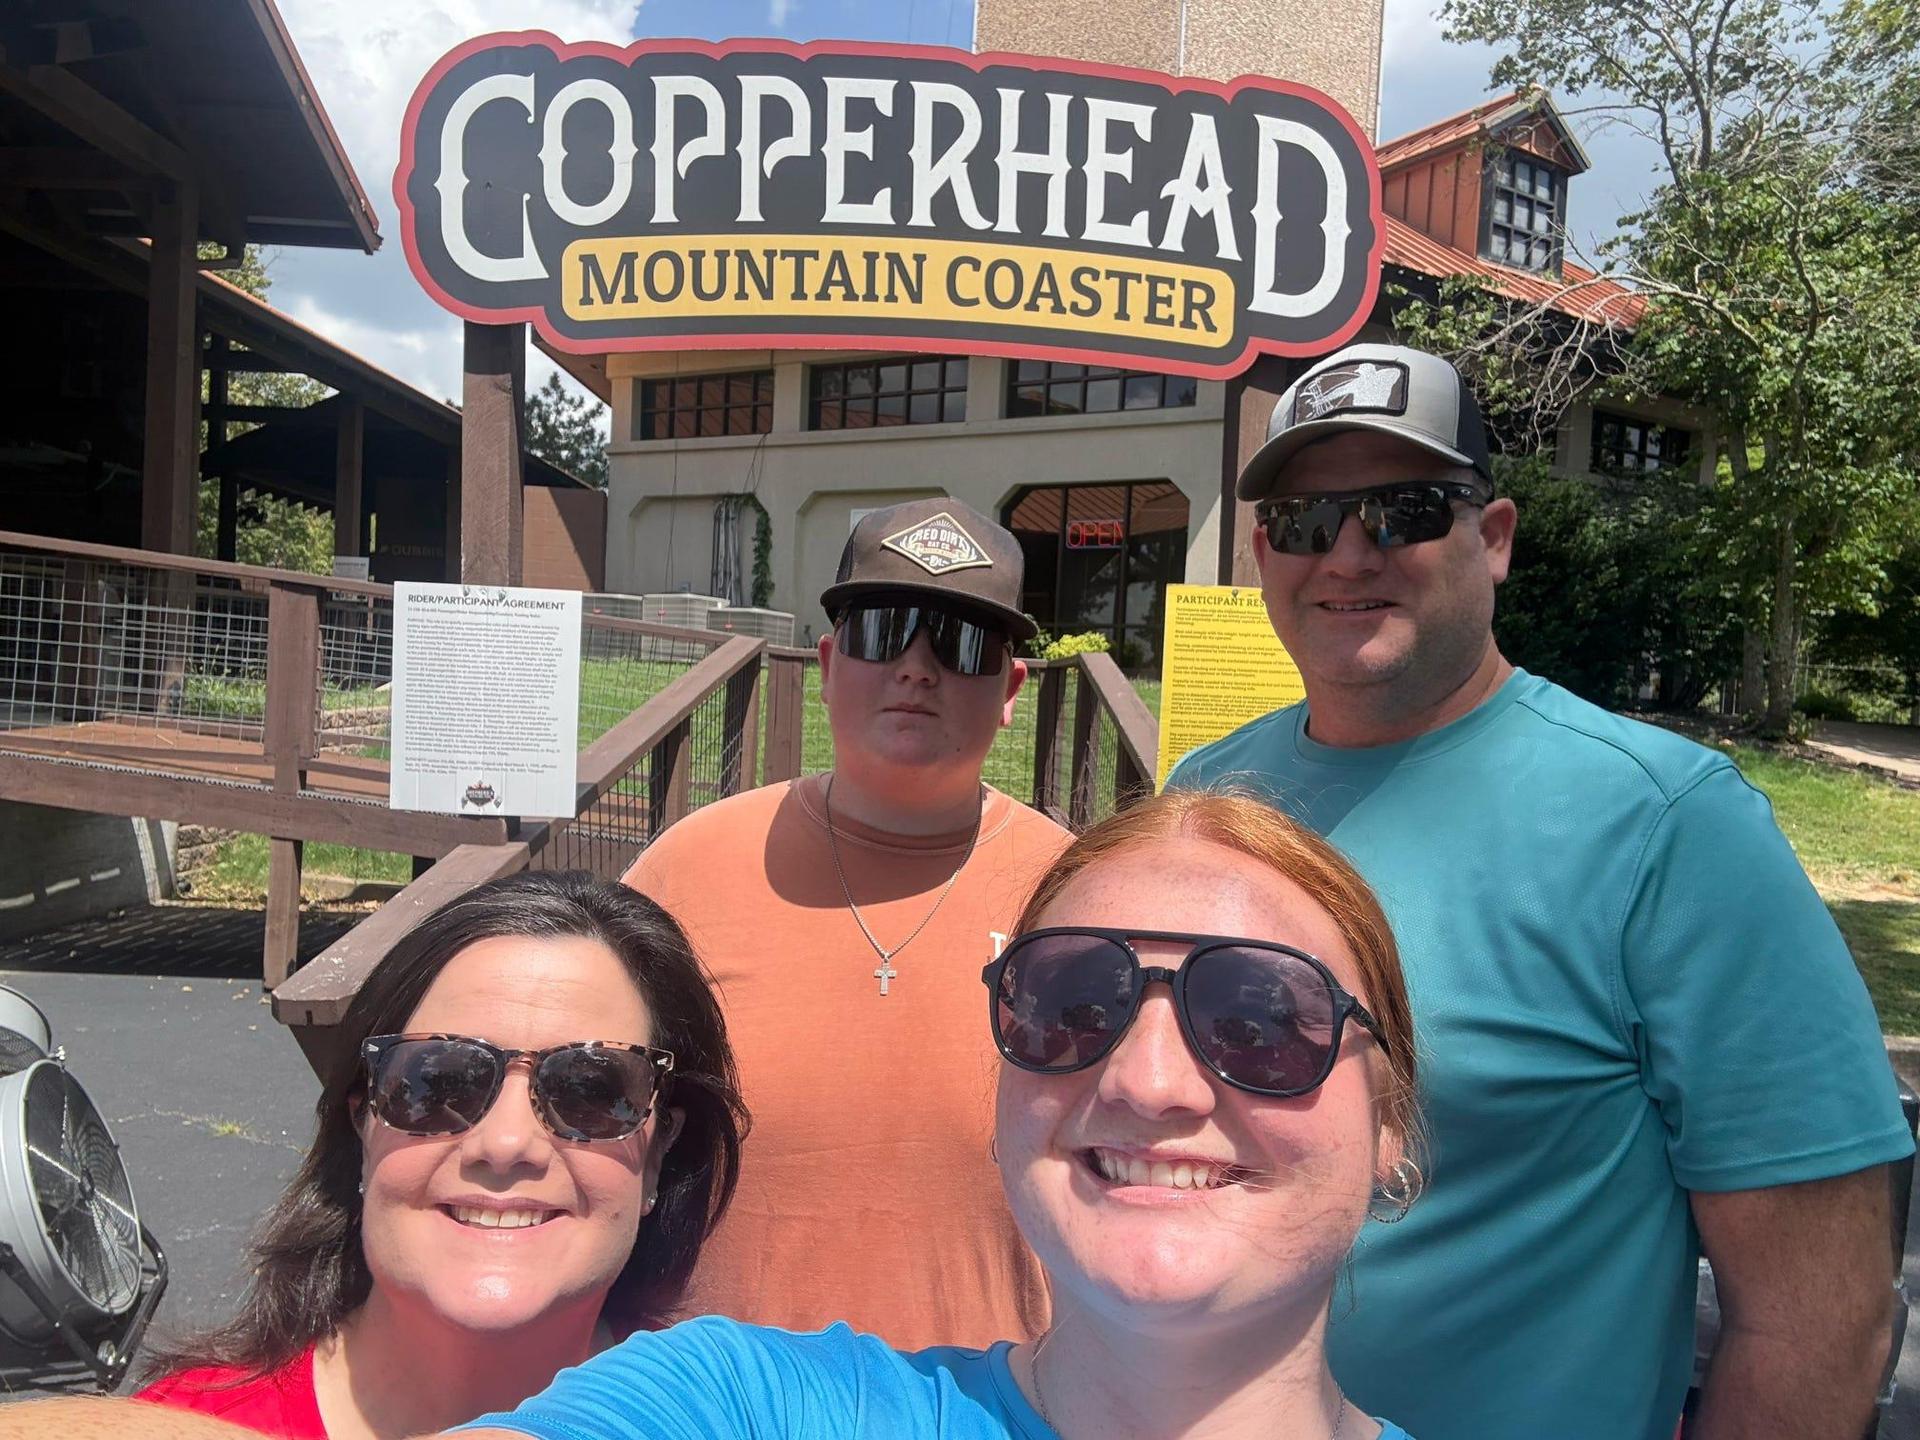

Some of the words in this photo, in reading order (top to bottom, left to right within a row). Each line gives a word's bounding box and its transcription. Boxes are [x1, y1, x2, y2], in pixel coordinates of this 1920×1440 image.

[433, 72, 1352, 319] COPPERHEAD
[578, 249, 928, 306] MOUNTAIN
[944, 255, 1218, 332] COASTER
[1068, 521, 1124, 547] OPEN
[408, 594, 500, 607] RIDER/PARTICIPANT
[503, 599, 565, 610] AGREEMENT
[1176, 595, 1244, 606] PARTICIPANT
